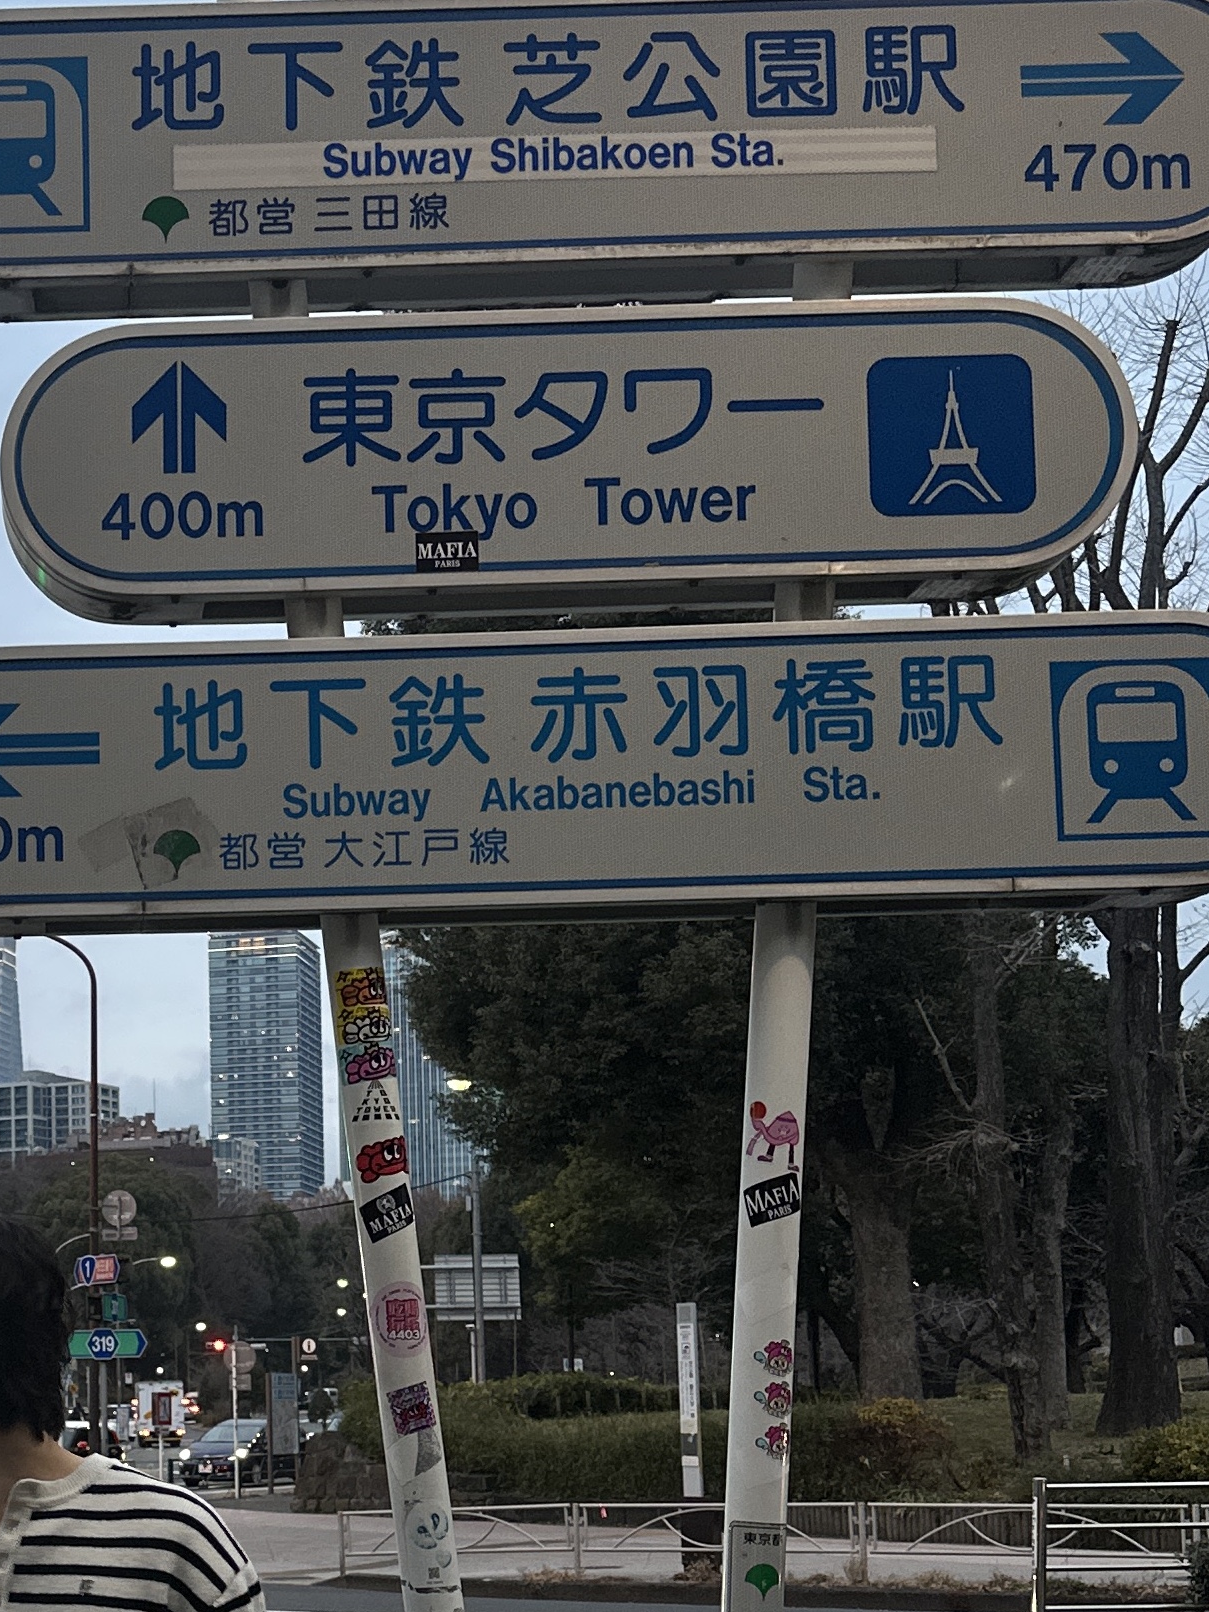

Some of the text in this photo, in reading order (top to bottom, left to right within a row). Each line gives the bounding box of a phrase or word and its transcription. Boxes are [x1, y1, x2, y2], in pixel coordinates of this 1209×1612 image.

[132, 24, 965, 131] 地下鉄 芝公園駅
[323, 132, 785, 182] Subway Shibakoen Sta.
[1023, 143, 1192, 192] 470m
[302, 366, 825, 467] 東京タワー
[101, 490, 265, 541] 400m
[372, 477, 757, 541] Tokyo Tower
[417, 541, 477, 559] MAFIA
[434, 559, 460, 568] PARIS
[153, 654, 1003, 771] 地下鉄 赤羽橋駅
[282, 765, 881, 822] Subway Akabanebashi Sta.
[746, 1179, 800, 1217] MAFIA
[767, 1203, 792, 1220] PARIS
[369, 1203, 412, 1234] MAFIA
[387, 1219, 407, 1234] PARIS
[92, 1336, 115, 1352] 319
[388, 1329, 420, 1340] 4403
[743, 1531, 783, 1546] 東京都
